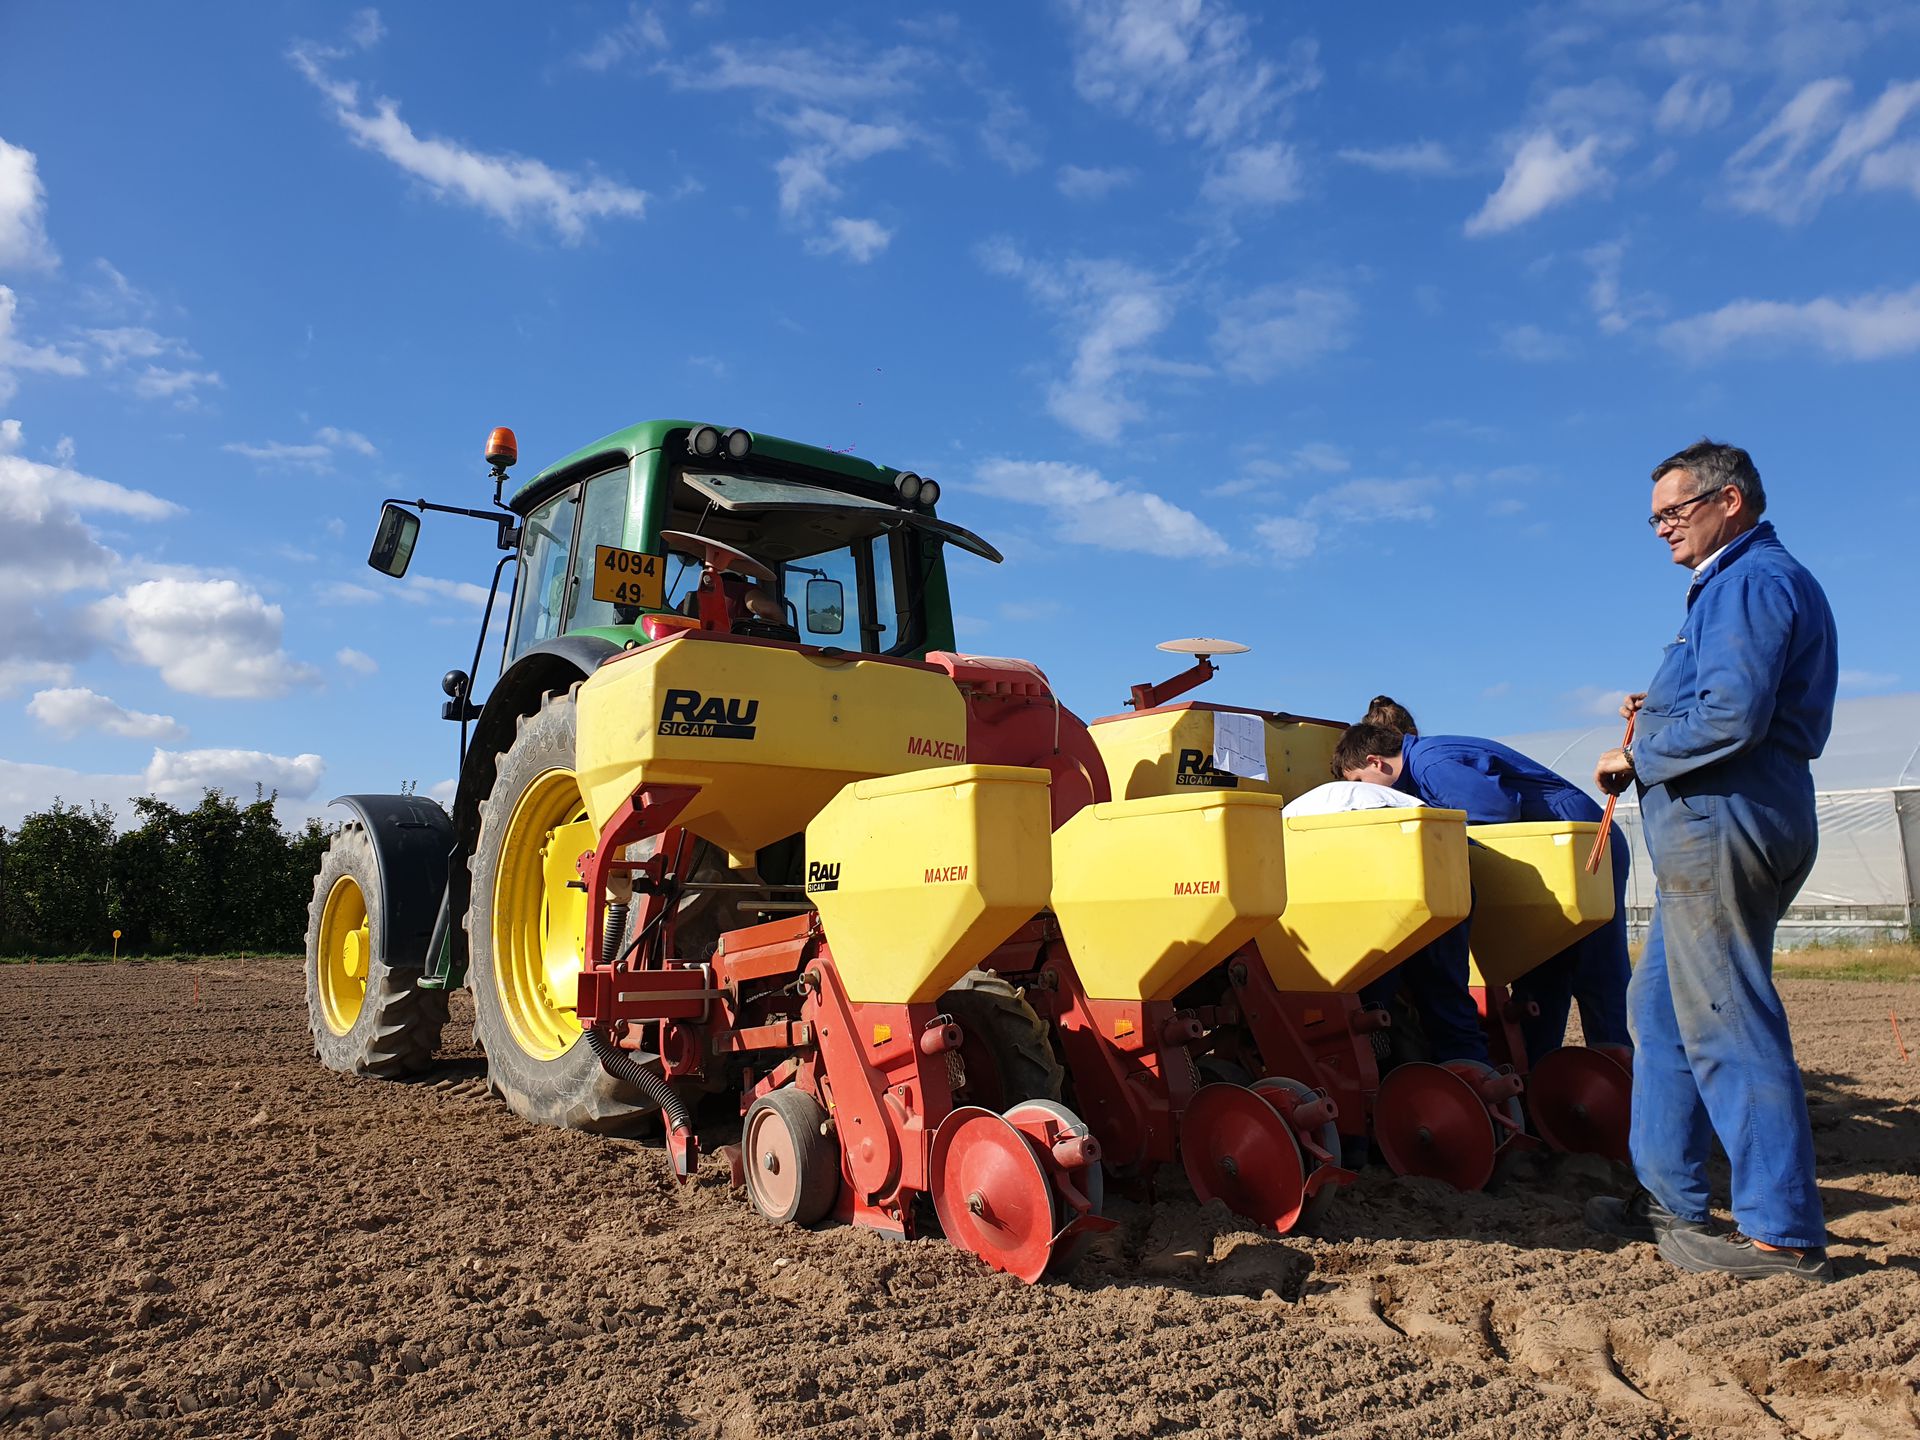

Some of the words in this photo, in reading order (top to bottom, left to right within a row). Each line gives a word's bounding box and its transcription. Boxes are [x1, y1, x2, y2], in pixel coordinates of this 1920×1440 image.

[604, 550, 655, 577] 4094
[615, 582, 641, 604] 49
[660, 688, 759, 725] RAU
[660, 722, 714, 736] SICAM
[907, 736, 966, 763] MAXEM
[1177, 748, 1237, 776] RA
[1177, 774, 1212, 785] SICAM
[808, 861, 841, 882] RAU
[924, 865, 968, 883] MAXEM
[808, 883, 826, 892] SICAM
[1174, 880, 1220, 895] MAXEM
